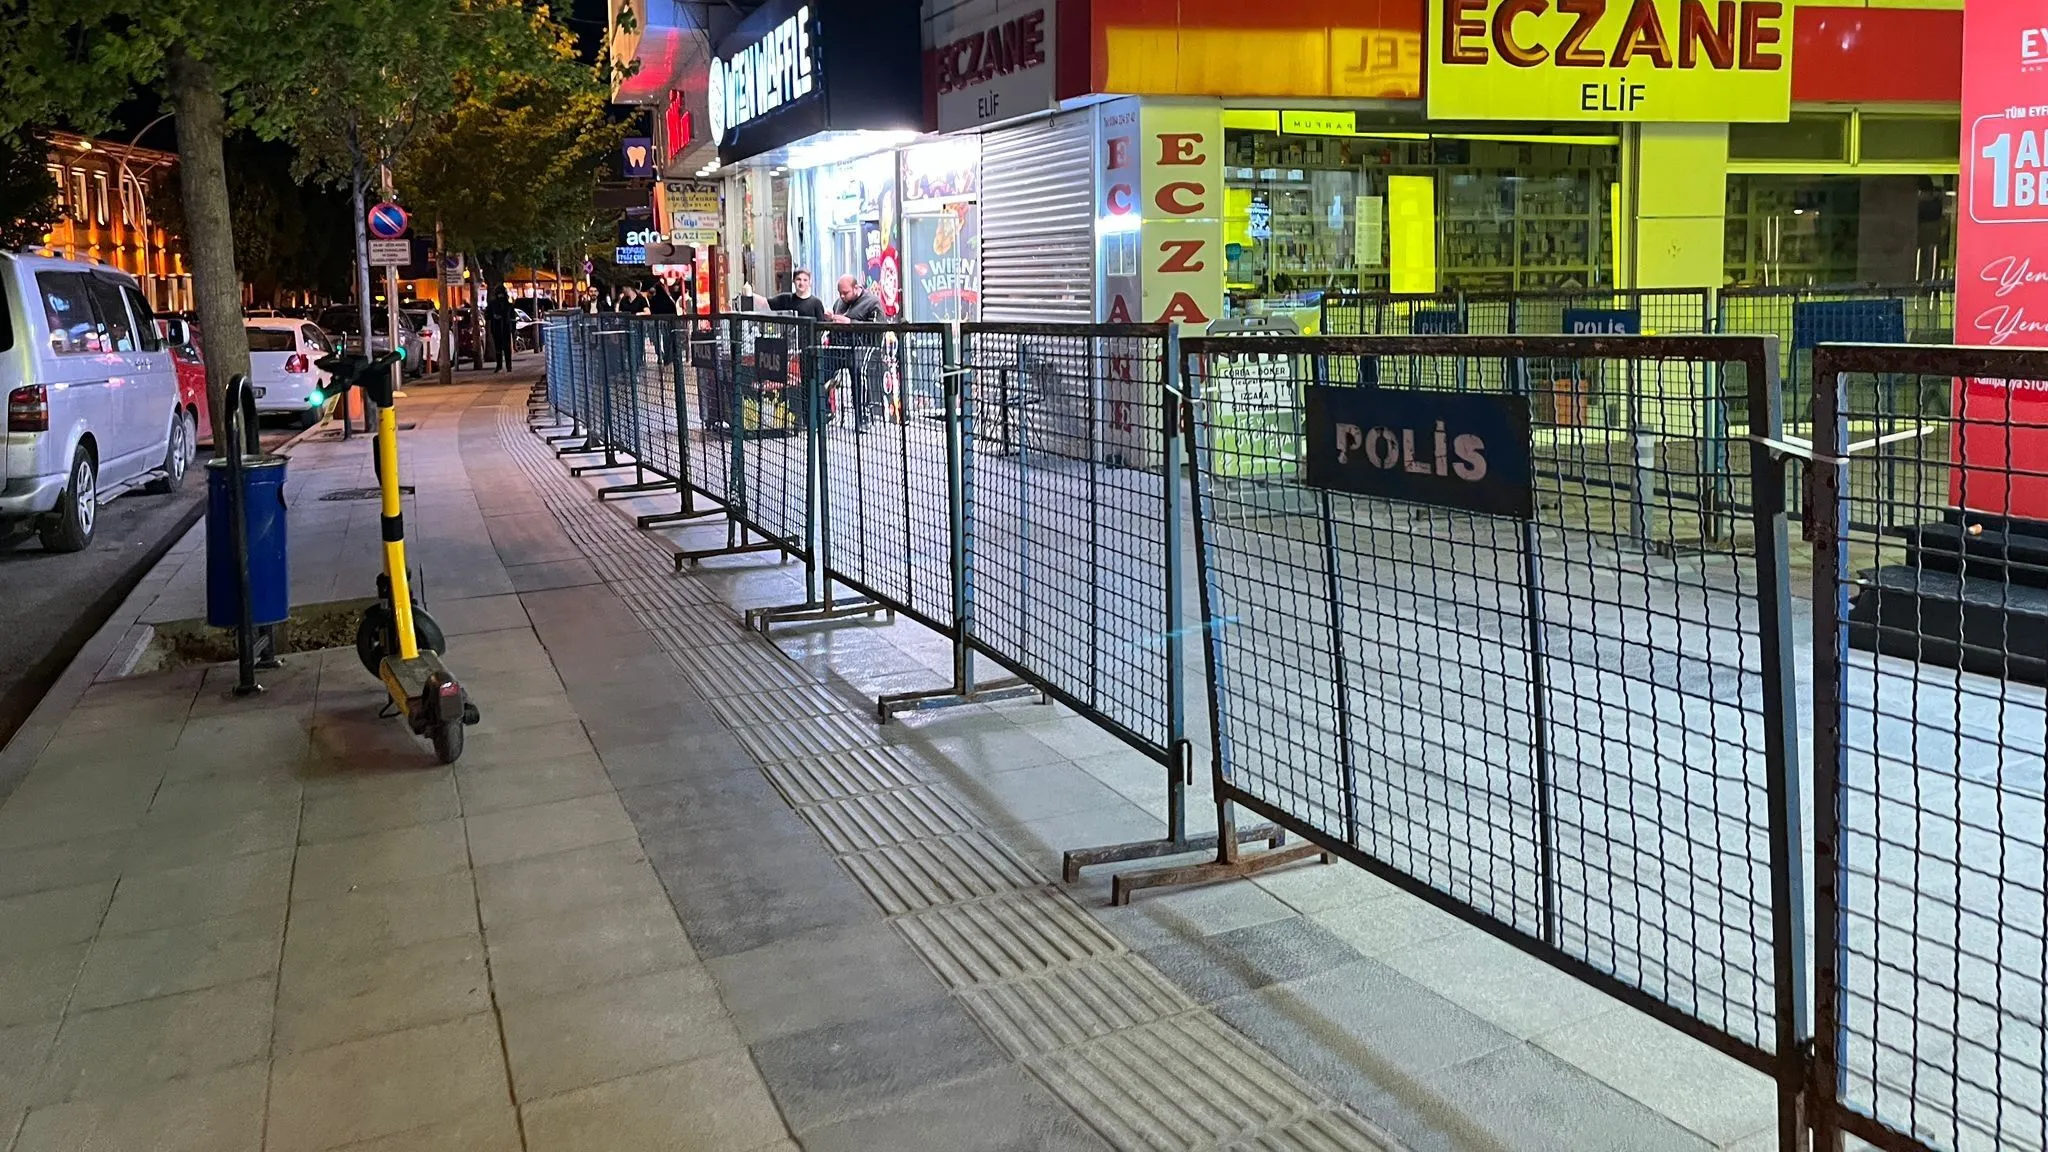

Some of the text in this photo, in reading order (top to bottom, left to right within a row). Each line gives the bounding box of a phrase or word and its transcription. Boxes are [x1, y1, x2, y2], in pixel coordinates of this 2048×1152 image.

[754, 5, 811, 116] WAFFLE
[937, 8, 1045, 95] ECZANE
[1442, 0, 1783, 70] ECZANE
[978, 90, 999, 118] ELİF
[1582, 77, 1645, 111] ELİF
[2005, 106, 2026, 119] TÜM
[1982, 133, 2011, 207] 1
[674, 231, 699, 241] GAZİ
[1336, 419, 1488, 482] POLİS
